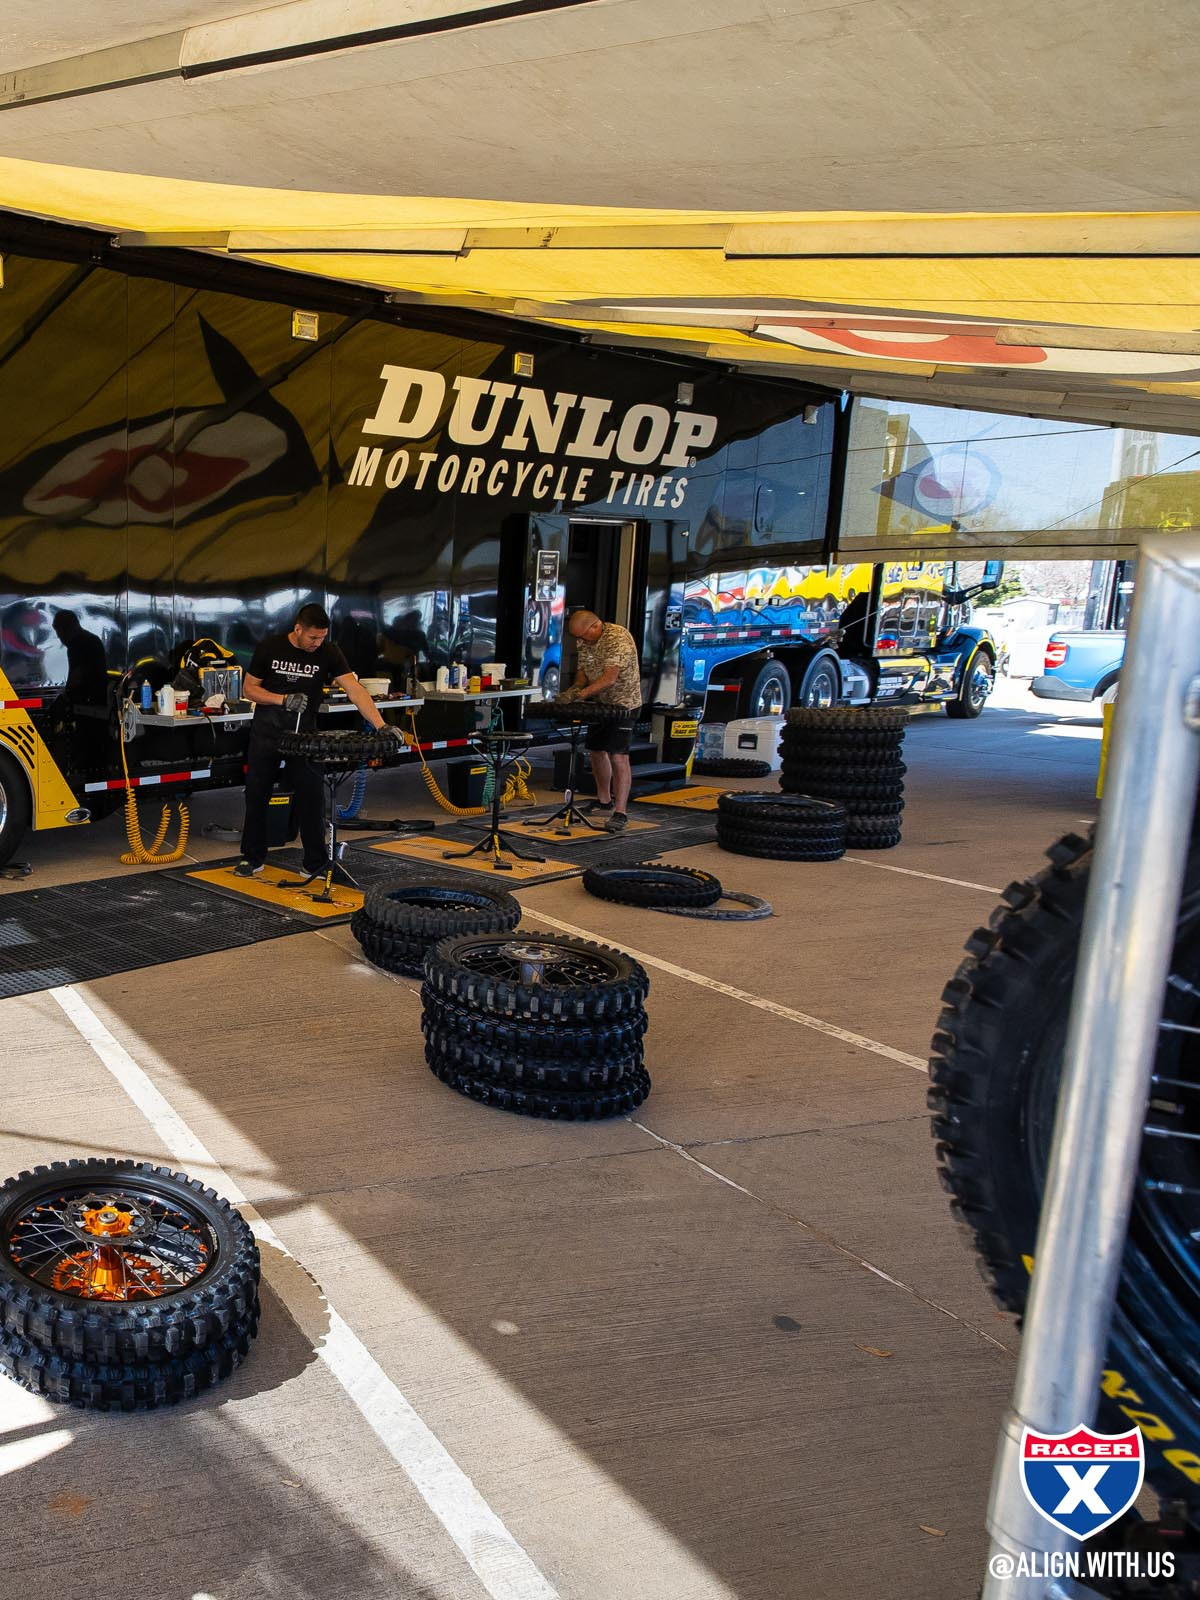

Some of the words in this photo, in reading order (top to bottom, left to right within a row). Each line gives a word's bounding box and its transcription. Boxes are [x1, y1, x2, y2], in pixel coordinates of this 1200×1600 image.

[362, 364, 718, 468] DUNLOP
[347, 446, 594, 502] MOTORCYCLE
[606, 470, 689, 509] TIRES
[271, 660, 320, 675] DUNLOP
